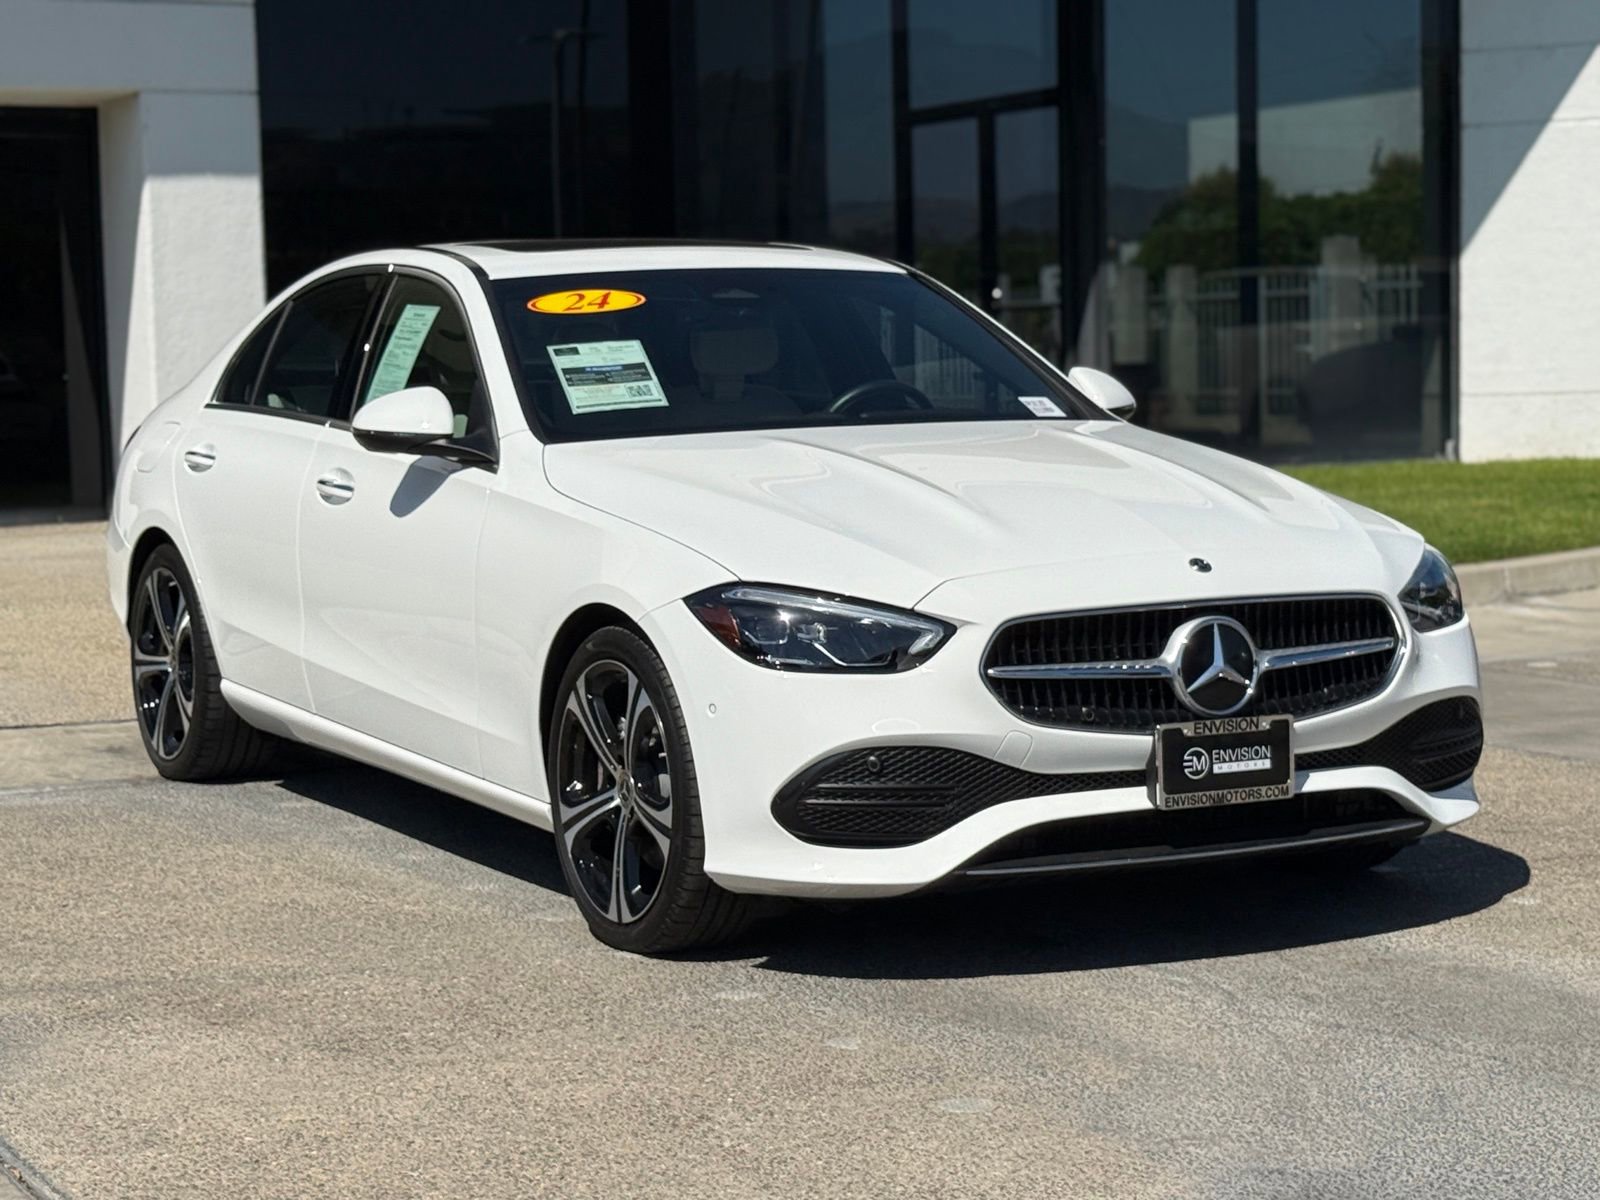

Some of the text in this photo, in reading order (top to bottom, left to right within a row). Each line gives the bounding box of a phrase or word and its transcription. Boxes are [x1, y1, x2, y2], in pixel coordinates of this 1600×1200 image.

[562, 291, 611, 311] 24
[1194, 717, 1260, 735] ENVISION
[1212, 745, 1271, 763] ENVISION
[1217, 761, 1266, 771] MOTORS
[1165, 785, 1289, 808] ENVISIONMOTORS.COM
